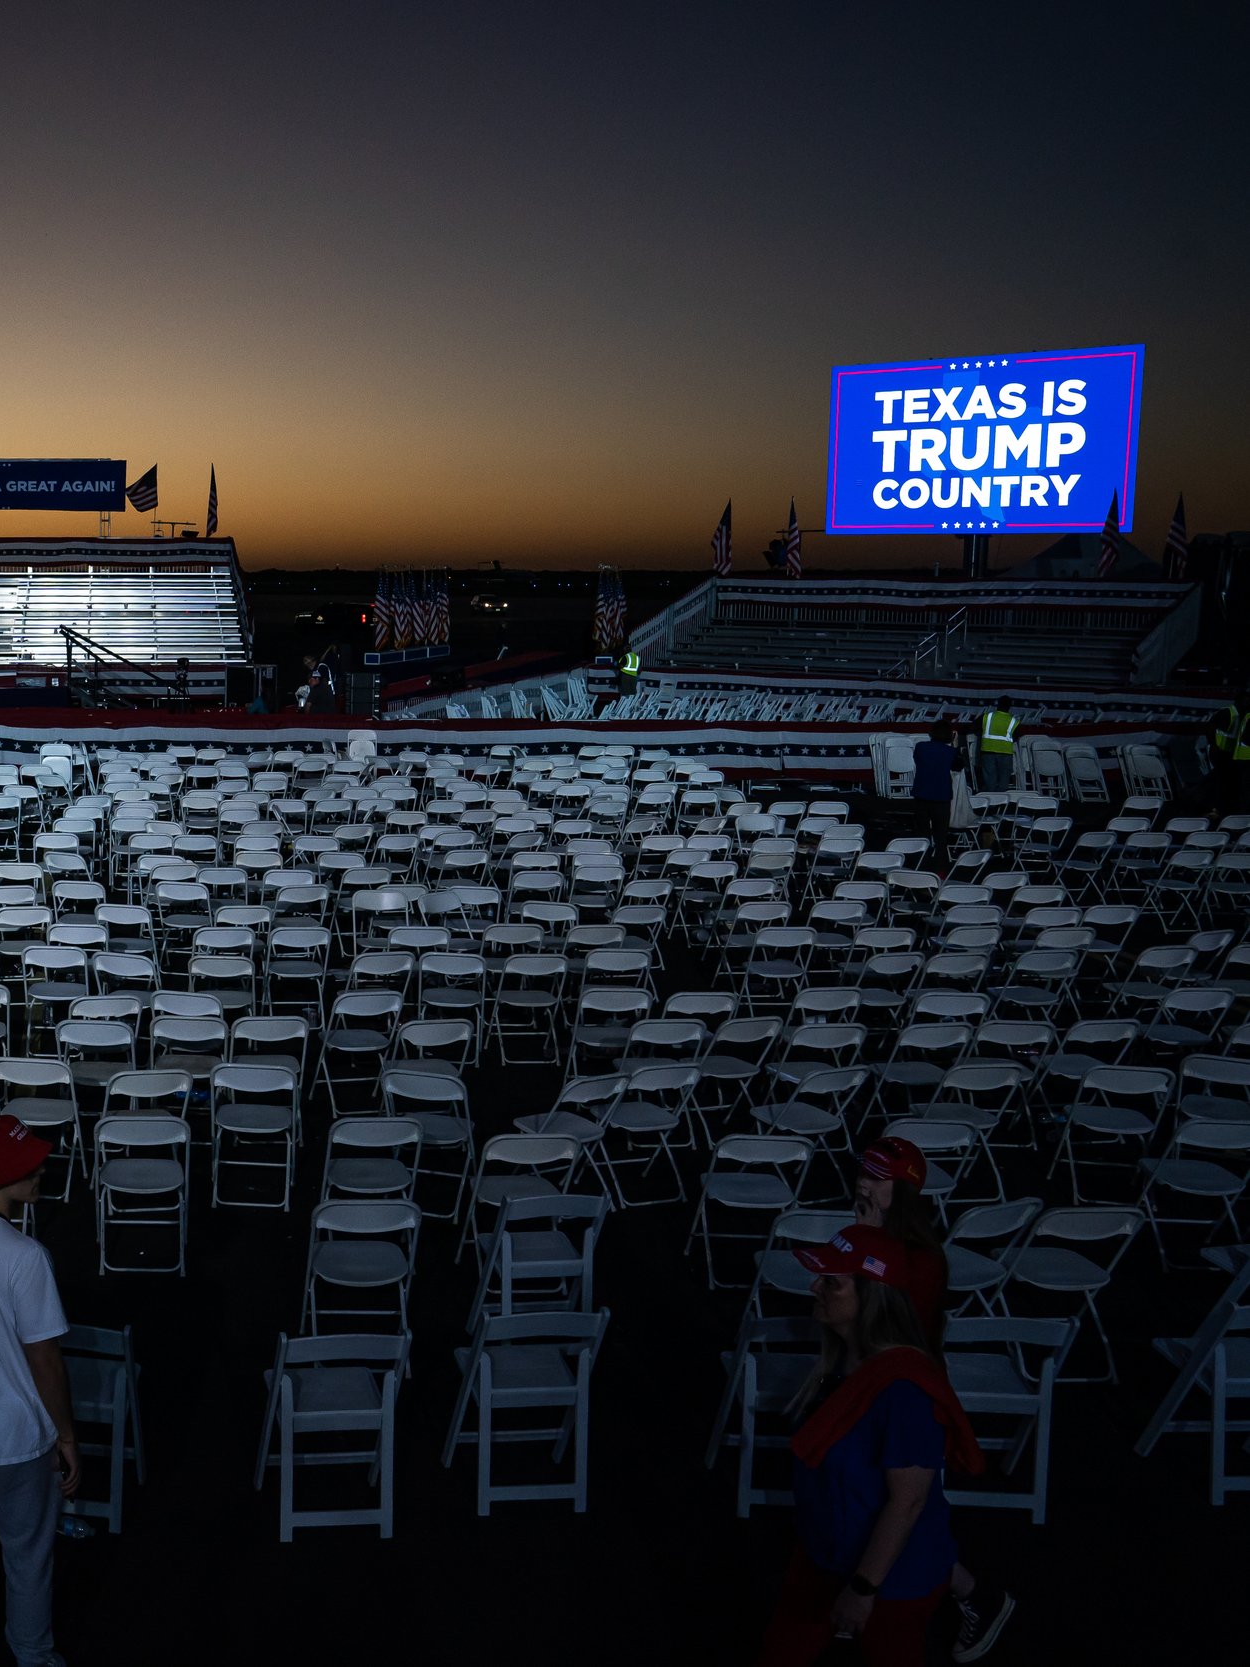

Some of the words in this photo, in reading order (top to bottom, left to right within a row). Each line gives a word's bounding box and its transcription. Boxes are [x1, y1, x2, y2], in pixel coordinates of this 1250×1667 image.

[874, 382, 1027, 425] TEXAS
[1041, 379, 1087, 418] IS
[872, 422, 1086, 473] TRUMP
[6, 480, 58, 492] GREAT
[61, 480, 116, 492] AGAIN!
[872, 474, 1082, 510] COUNTRY
